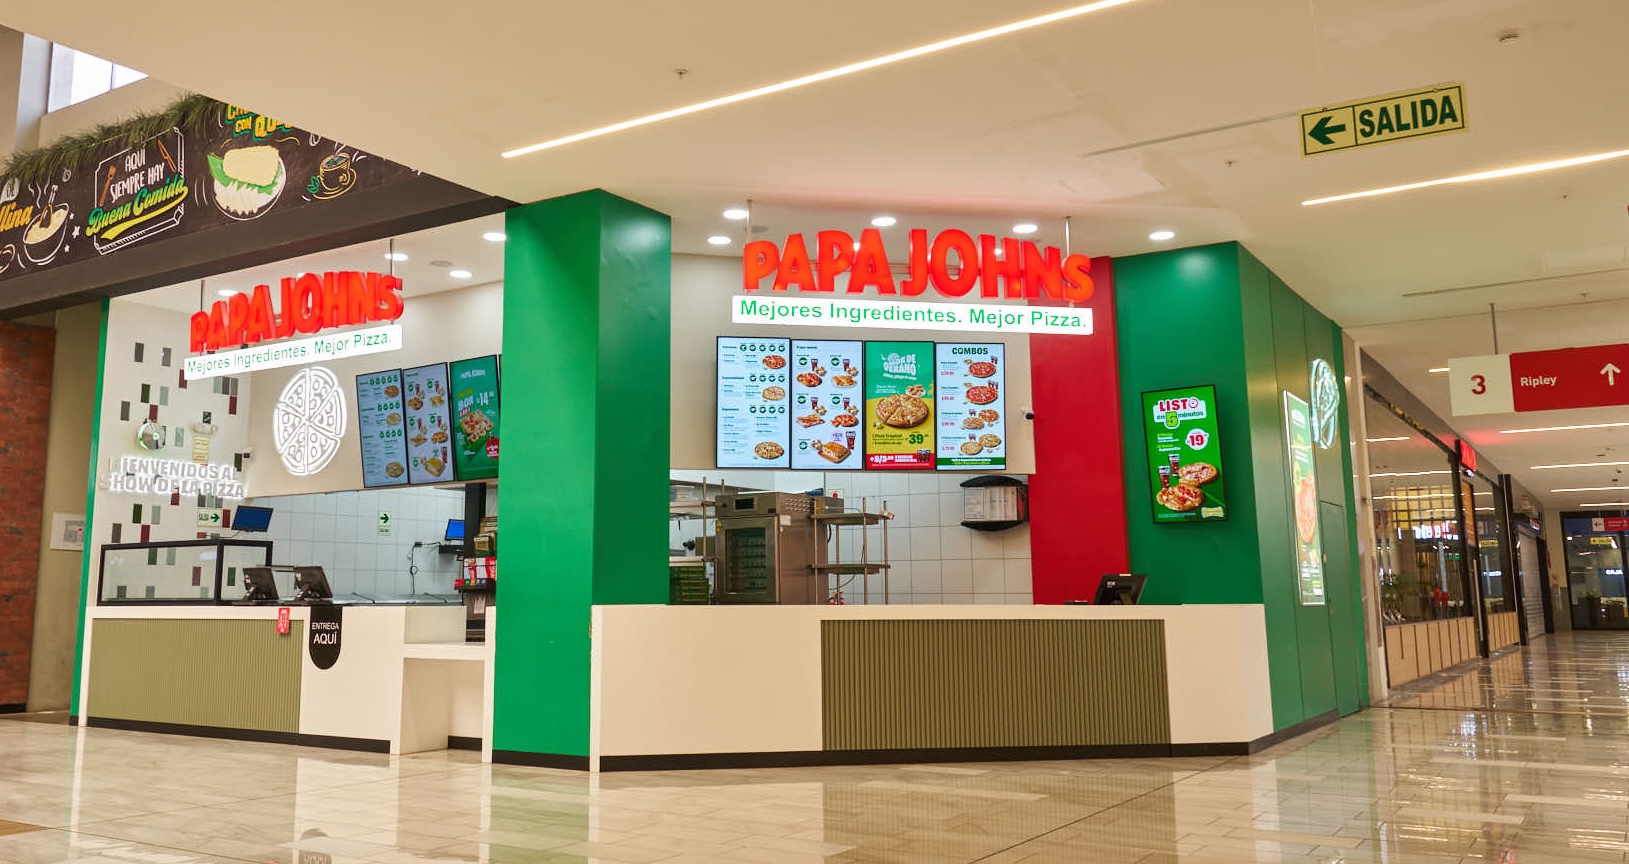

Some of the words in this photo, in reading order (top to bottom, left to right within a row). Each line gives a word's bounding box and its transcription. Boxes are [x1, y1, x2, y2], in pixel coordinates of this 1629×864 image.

[1359, 95, 1458, 138] SALIDA
[110, 171, 145, 203] SIEMPRE
[148, 162, 164, 185] HAY
[85, 202, 132, 236] Buena
[133, 173, 186, 216] Comida
[743, 228, 897, 295] PAPA
[901, 229, 1095, 303] JOHNS
[190, 284, 276, 352] PAPA
[276, 271, 404, 339] JOHNS
[740, 300, 823, 320] Mejores
[830, 303, 962, 323] Ingredientes.
[969, 308, 1024, 328] Mejor
[1031, 311, 1086, 327] Pizza.
[188, 358, 230, 375] Mejores
[234, 345, 310, 368] Ingredientes.
[314, 338, 349, 355] Mejor
[353, 332, 392, 348] Pizza.
[952, 347, 989, 355] COMBOS
[1471, 374, 1486, 395] 3
[1520, 375, 1557, 387] Ripley
[1165, 411, 1178, 427] 5
[1178, 411, 1204, 419] minutos
[909, 433, 924, 445] 39
[1189, 434, 1204, 446] 19
[109, 457, 218, 479] IENVENIDOS
[202, 482, 245, 499] PIZZA
[311, 622, 340, 630] ENTREGA
[313, 631, 337, 645] AQUÍ
